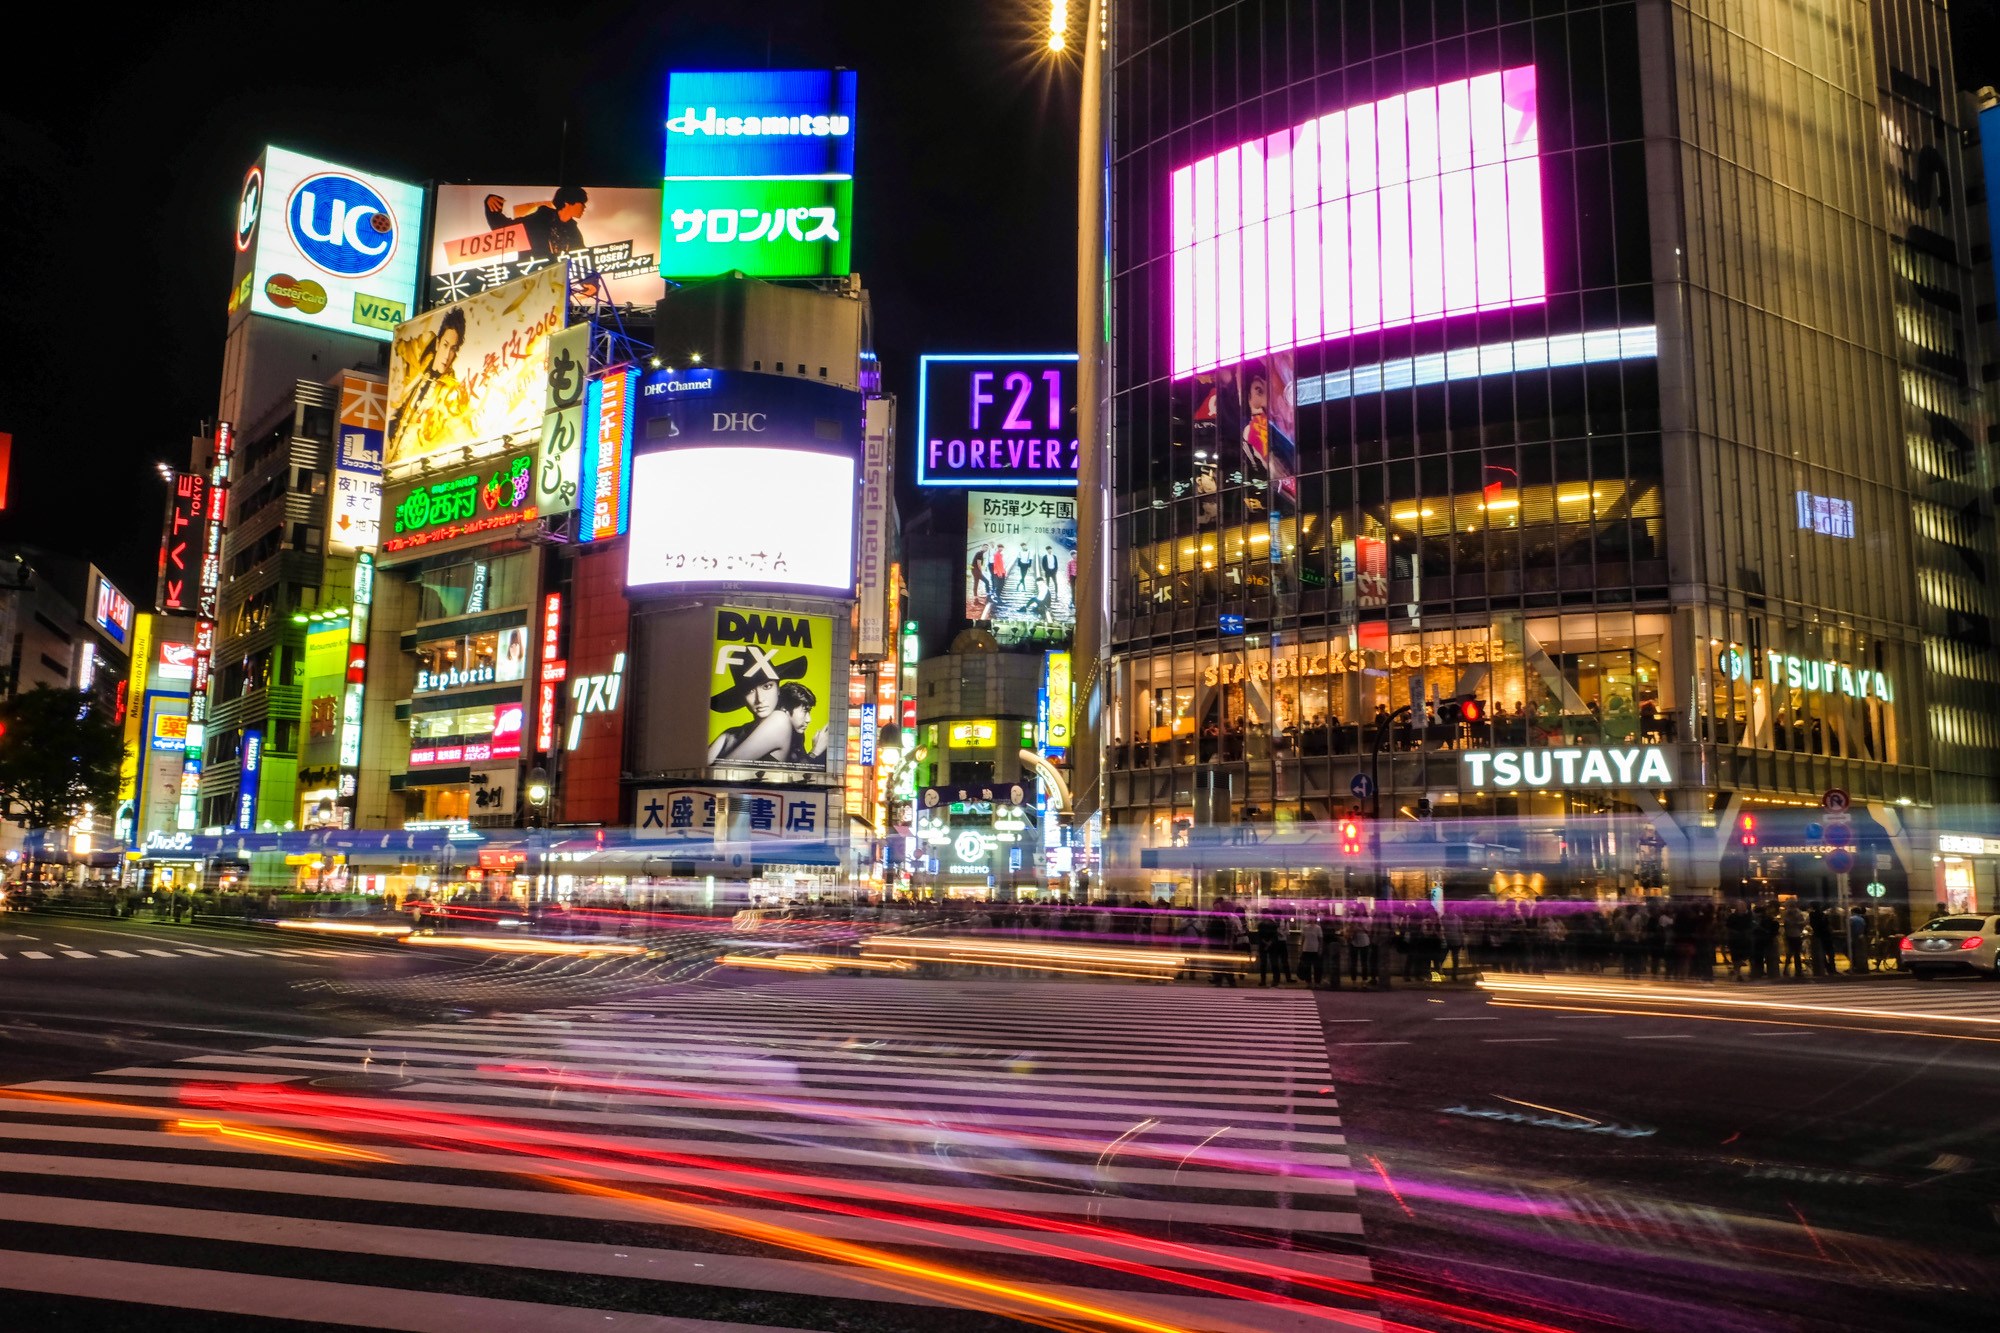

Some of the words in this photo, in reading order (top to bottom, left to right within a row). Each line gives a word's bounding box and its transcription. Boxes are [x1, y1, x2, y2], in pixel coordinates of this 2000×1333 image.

[667, 107, 850, 136] Hisamitsu
[671, 207, 840, 243] サロンパス
[459, 229, 516, 258] LOSER
[609, 243, 630, 252] Single
[596, 257, 651, 273] ナンバーナイン
[266, 282, 326, 305] MasterCard
[360, 302, 403, 324] VISA
[525, 304, 558, 346] 2016
[341, 380, 386, 429] 本
[645, 383, 668, 396] DHC
[667, 378, 712, 393] Channel
[968, 370, 1061, 430] F21
[541, 347, 585, 507] もんじゃ
[712, 412, 767, 433] DHC
[593, 379, 619, 529] 三千里薬品
[866, 427, 885, 511] Taisei
[929, 439, 1062, 469] FOREVER
[191, 476, 204, 517] TOKYO
[346, 495, 373, 511] まで
[429, 487, 478, 526] 西村
[983, 522, 1020, 535] YOUTH
[863, 518, 881, 589] neon
[722, 581, 743, 591] DHC
[716, 610, 813, 649] DMM
[417, 665, 494, 692] Euphoria
[714, 644, 780, 680] FX
[1203, 648, 1366, 688] STARBUCKS
[1384, 639, 1505, 669] COFFEE
[1767, 653, 1895, 705] TSUTAYA
[131, 669, 144, 719] Matsumoto
[162, 716, 187, 737] 薬
[246, 737, 260, 771] MIZUHO
[1464, 748, 1673, 787] TSUTAYA
[1761, 845, 1819, 855] STARBUCKS
